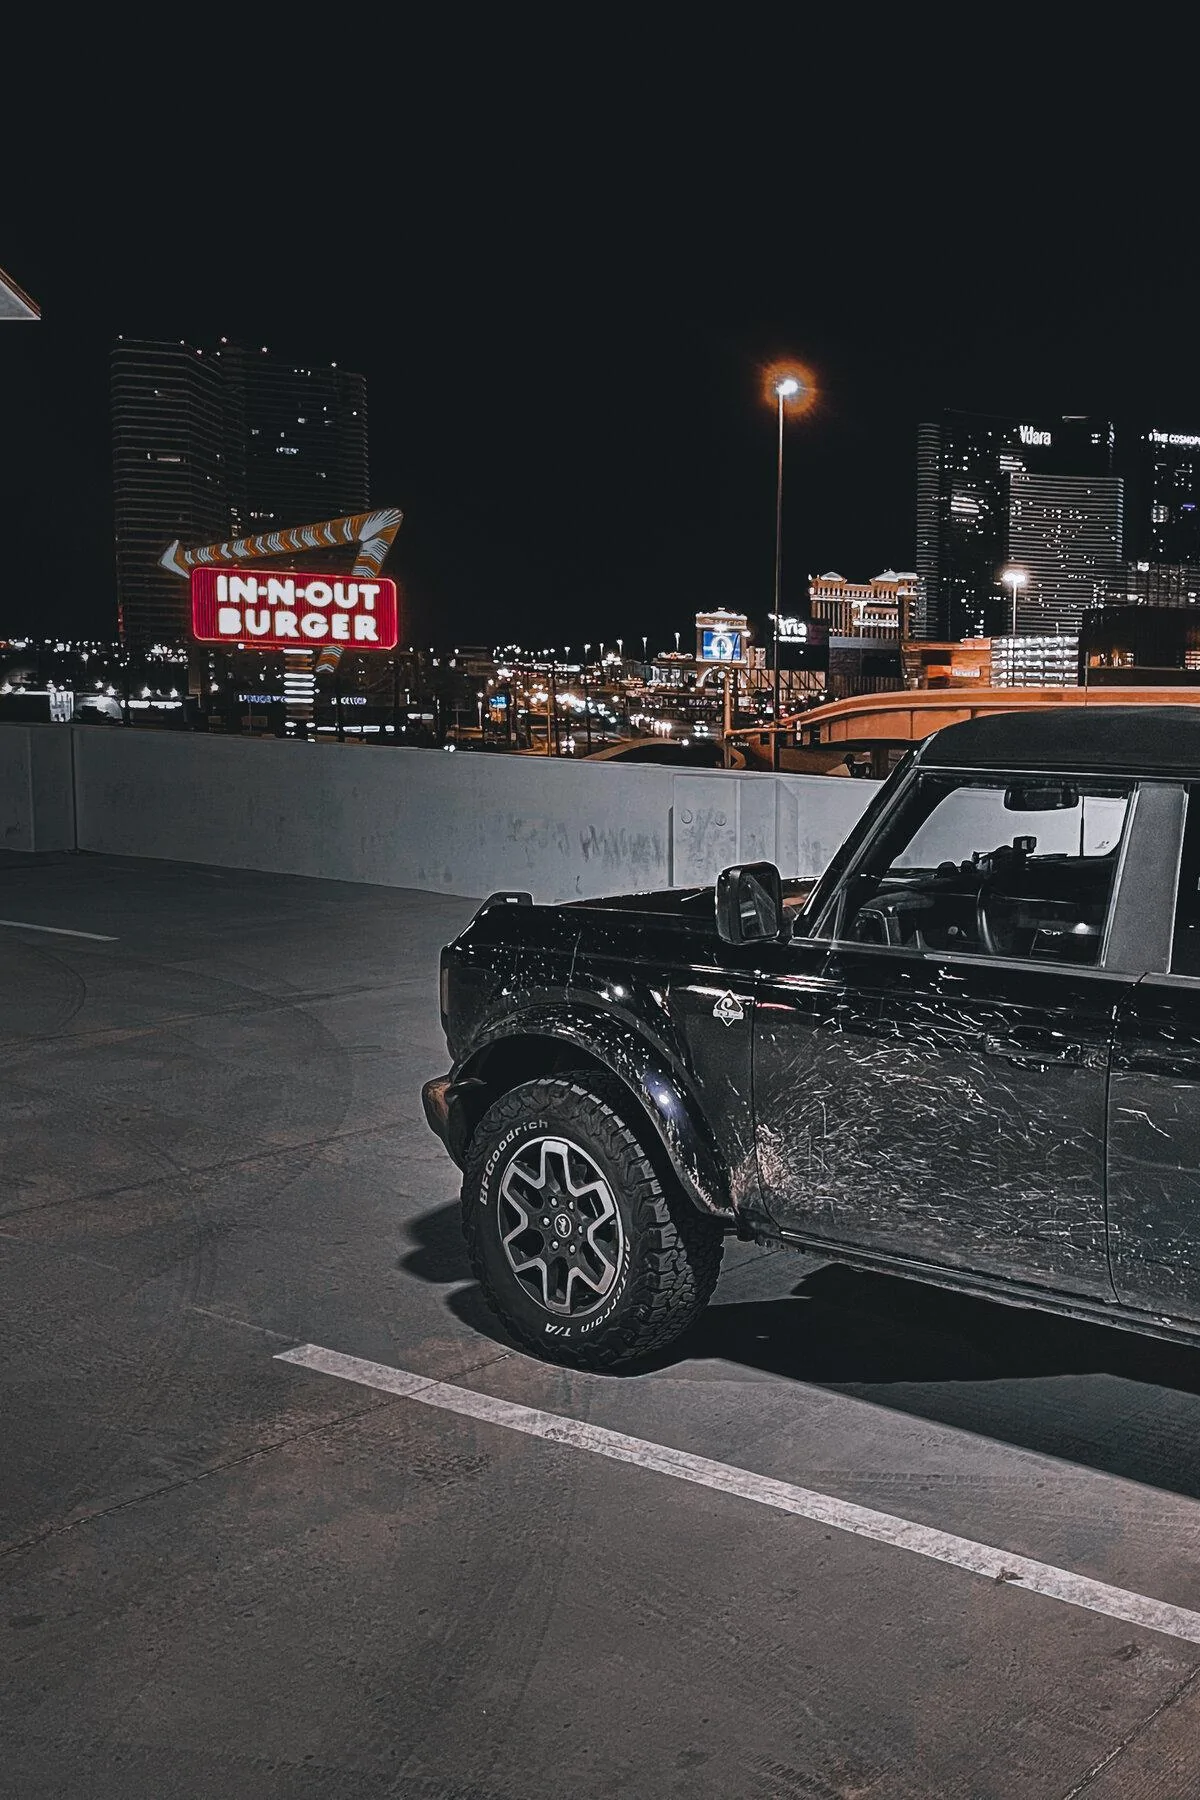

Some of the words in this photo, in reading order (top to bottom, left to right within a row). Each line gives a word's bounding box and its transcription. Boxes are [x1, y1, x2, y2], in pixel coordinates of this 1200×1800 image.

[1019, 425, 1051, 445] Vdara
[1153, 433, 1169, 443] THE
[217, 575, 380, 610] IN-N-OUT
[218, 607, 379, 641] BURGER
[480, 1119, 548, 1206] BFGoodrich
[544, 1322, 572, 1337] T/A
